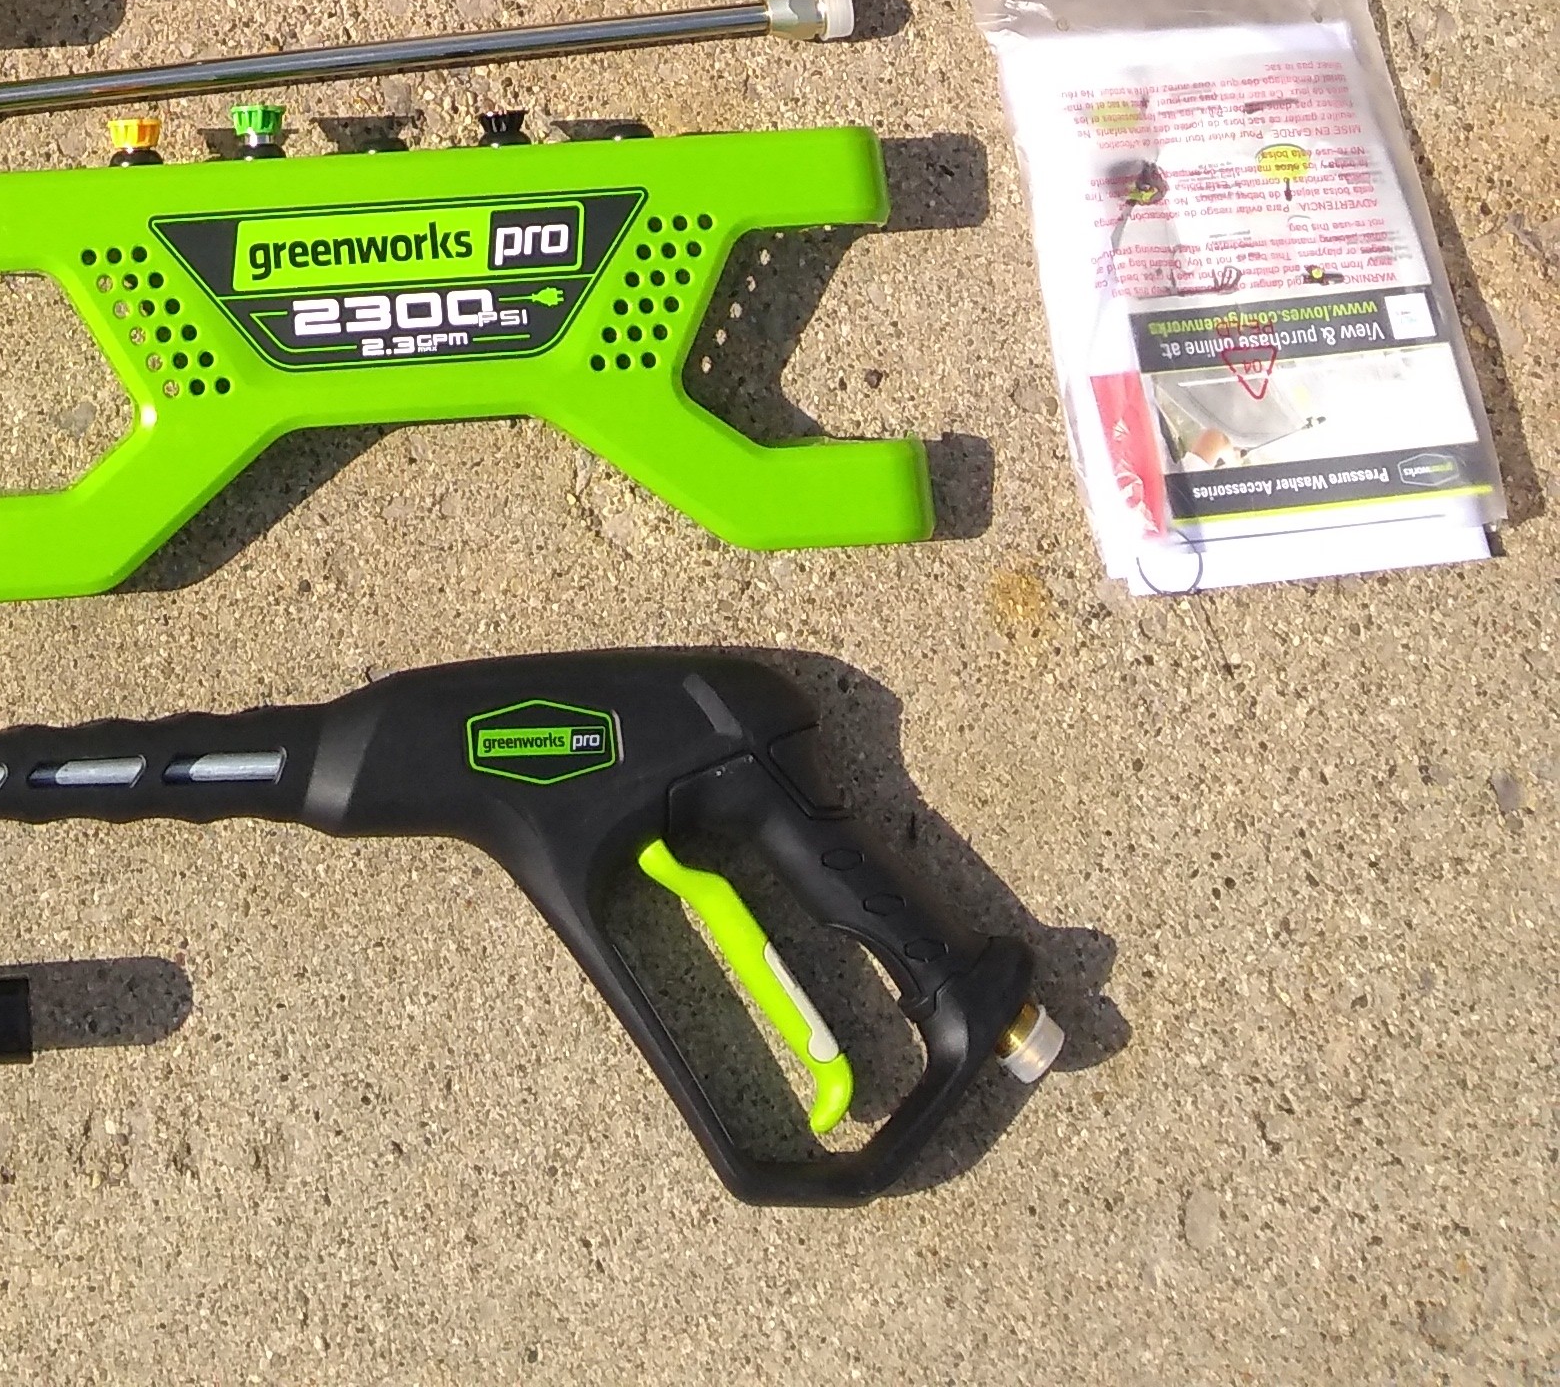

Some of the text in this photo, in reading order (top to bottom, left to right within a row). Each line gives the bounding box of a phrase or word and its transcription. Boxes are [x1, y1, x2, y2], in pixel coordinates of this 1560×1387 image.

[249, 221, 569, 280] greenworks pro
[292, 289, 528, 335] 2300 PSI
[1238, 324, 1316, 349] purchase
[1320, 326, 1335, 345] &
[1340, 321, 1384, 340] View
[361, 332, 469, 356] 2.3 GPM
[1184, 337, 1233, 357] online
[1240, 359, 1261, 373] 04
[1192, 467, 1388, 500] Pressure Washer Accessories
[483, 732, 600, 753] greenworks pro
